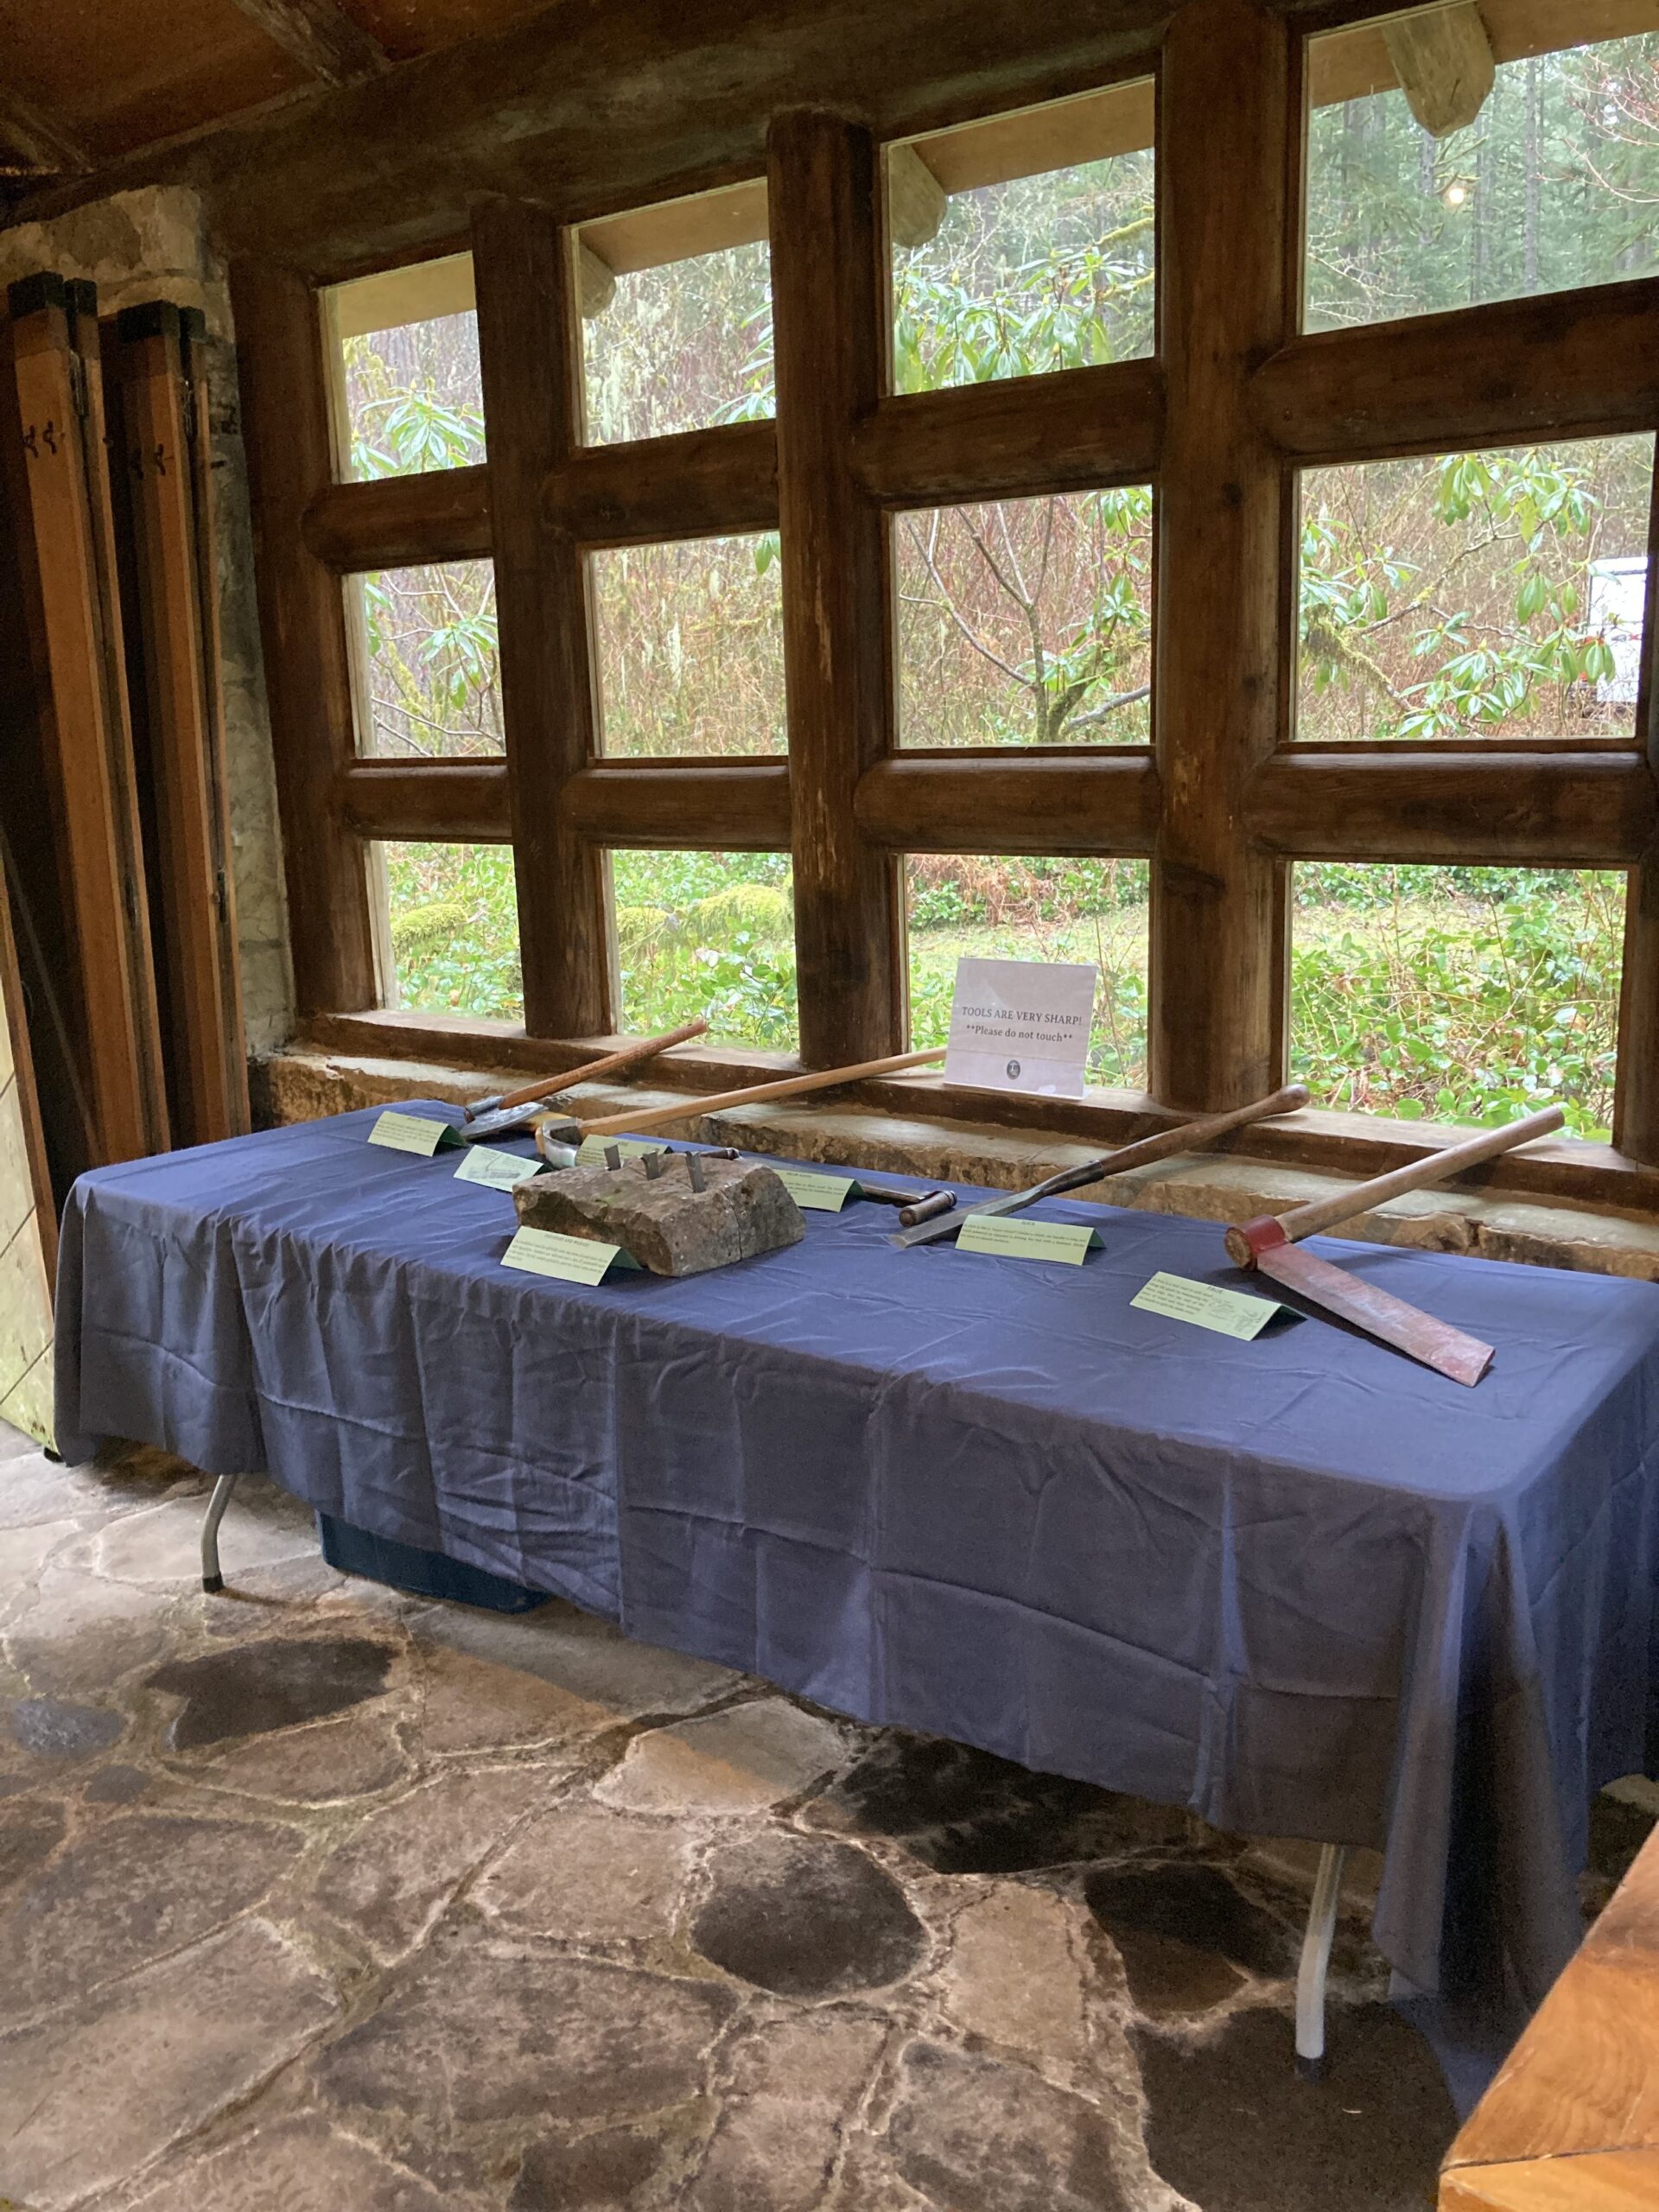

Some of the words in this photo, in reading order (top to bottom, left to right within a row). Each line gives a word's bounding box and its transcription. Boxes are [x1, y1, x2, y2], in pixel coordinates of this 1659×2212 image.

[962, 1007, 992, 1018] TOOLS
[995, 1009, 1014, 1020] ARE
[1016, 1011, 1043, 1022] VERY
[1045, 1014, 1082, 1026] SHARP!
[1005, 1028, 1016, 1038] do
[1019, 1030, 1033, 1039] not
